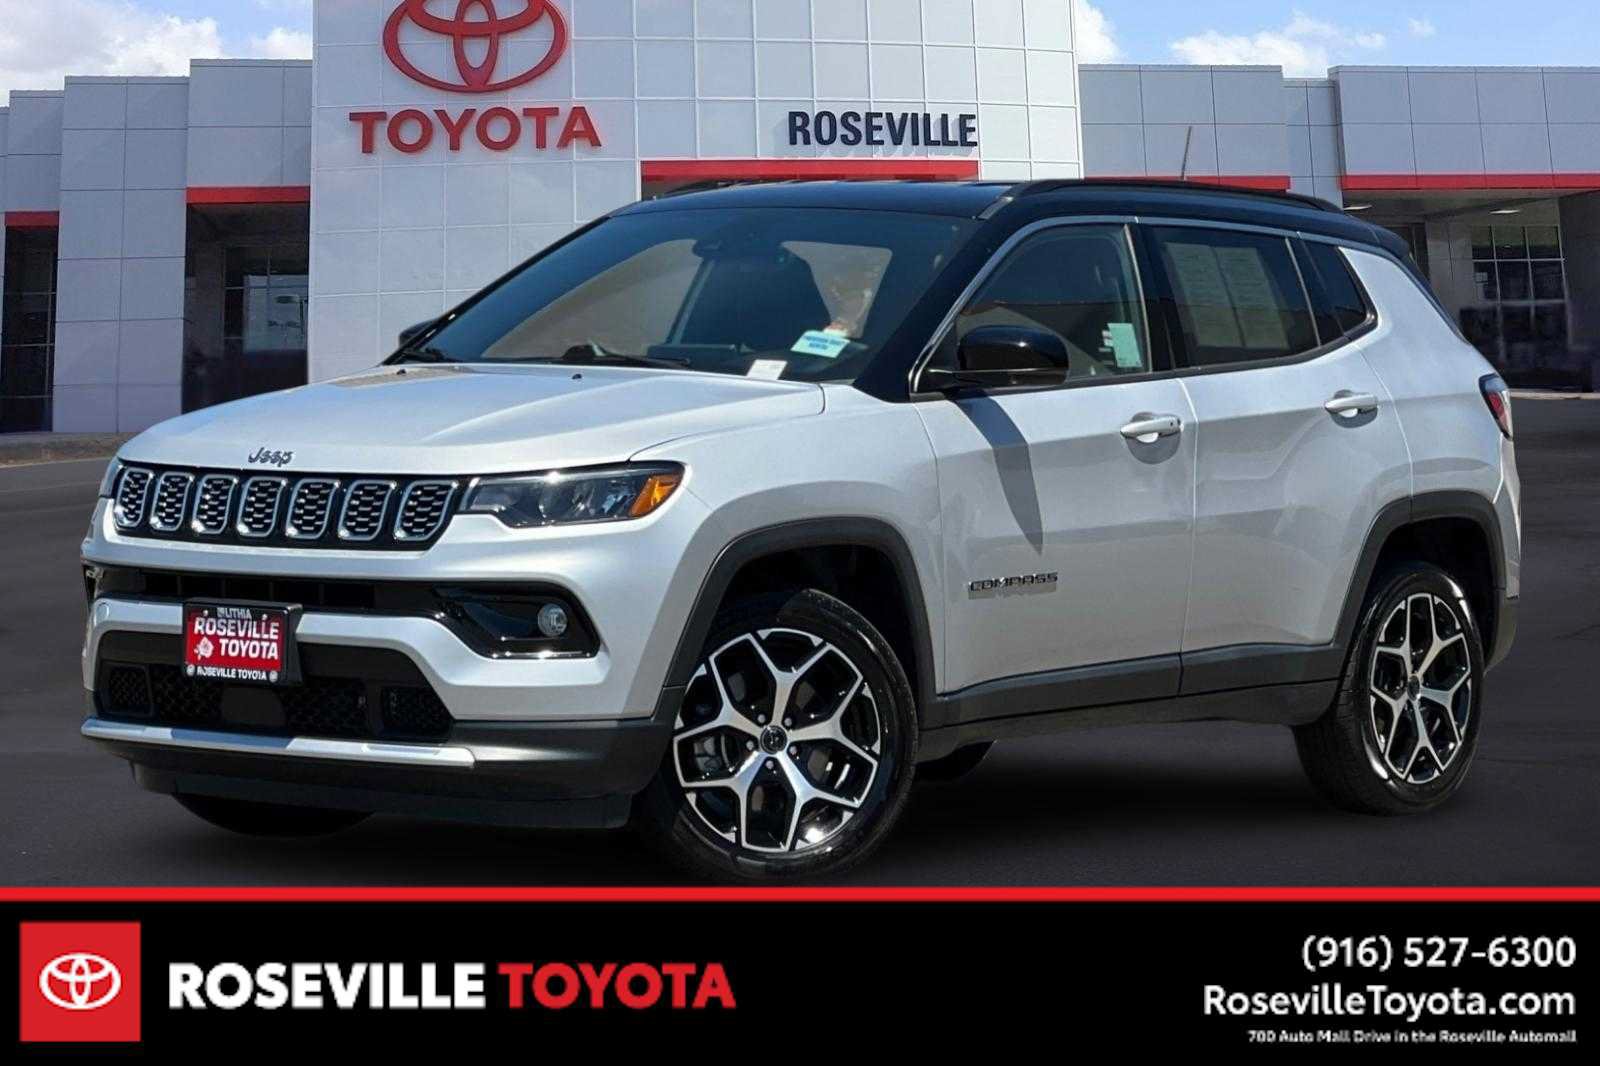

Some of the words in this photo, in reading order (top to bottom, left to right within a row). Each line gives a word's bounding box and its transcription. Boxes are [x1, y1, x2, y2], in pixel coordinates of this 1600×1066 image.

[349, 106, 602, 154] TOYOTA
[788, 110, 978, 147] ROSEVILLE
[247, 447, 294, 468] Jeep
[969, 571, 1058, 592] COMPASS
[193, 617, 280, 640] ROSEVILLE
[219, 638, 279, 660] TOYOTA
[196, 665, 237, 679] ROSEVILLE
[238, 668, 268, 681] TOYOTA
